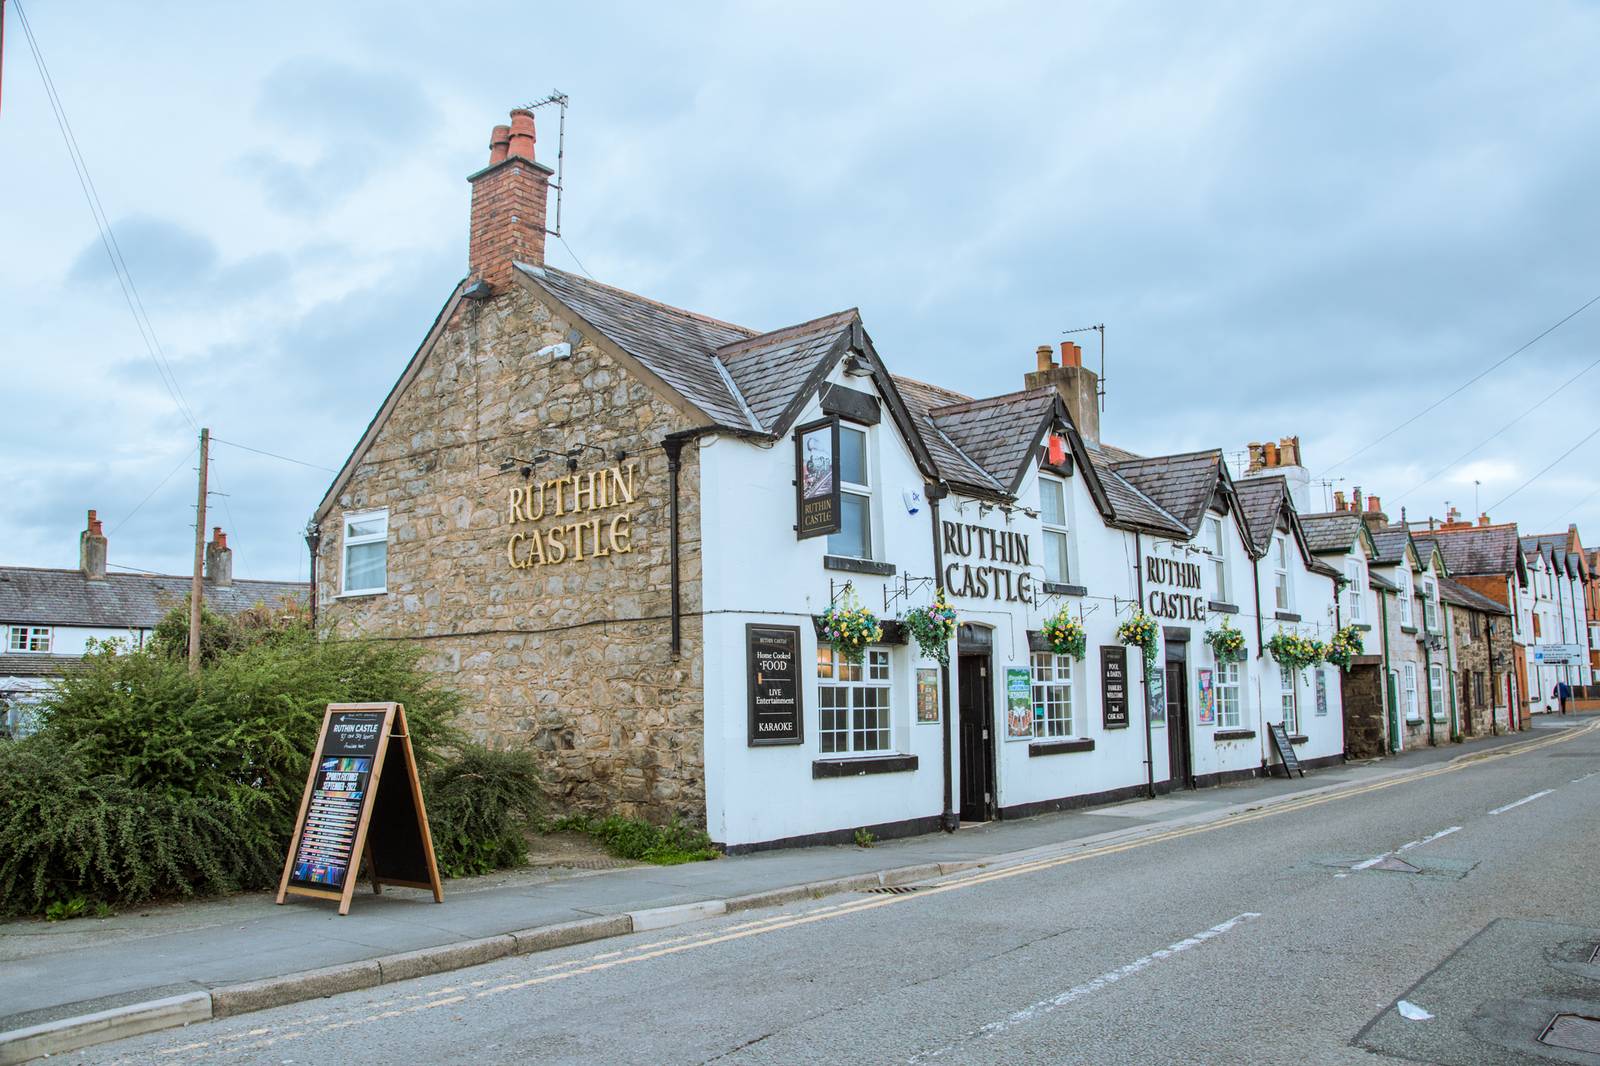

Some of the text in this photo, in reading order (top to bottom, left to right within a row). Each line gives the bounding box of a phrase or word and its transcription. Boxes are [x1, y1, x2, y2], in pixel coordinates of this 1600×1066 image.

[509, 464, 635, 525] RUTHIN
[804, 499, 832, 514] RUTHIN
[804, 511, 832, 526] CASTLE
[507, 512, 633, 569] CASTLE
[942, 520, 1032, 566] RUTHIN
[1146, 556, 1201, 589] RUTHIN
[945, 562, 1033, 604] CASTLE
[1149, 591, 1205, 621] CASTLE
[757, 651, 791, 660] Home Cooked
[762, 660, 787, 671] FOOD
[769, 688, 782, 697] LIVE
[756, 696, 794, 705] Entertainment
[334, 724, 378, 732] RUTHIN CASTLE
[758, 722, 793, 732] KARAOKE
